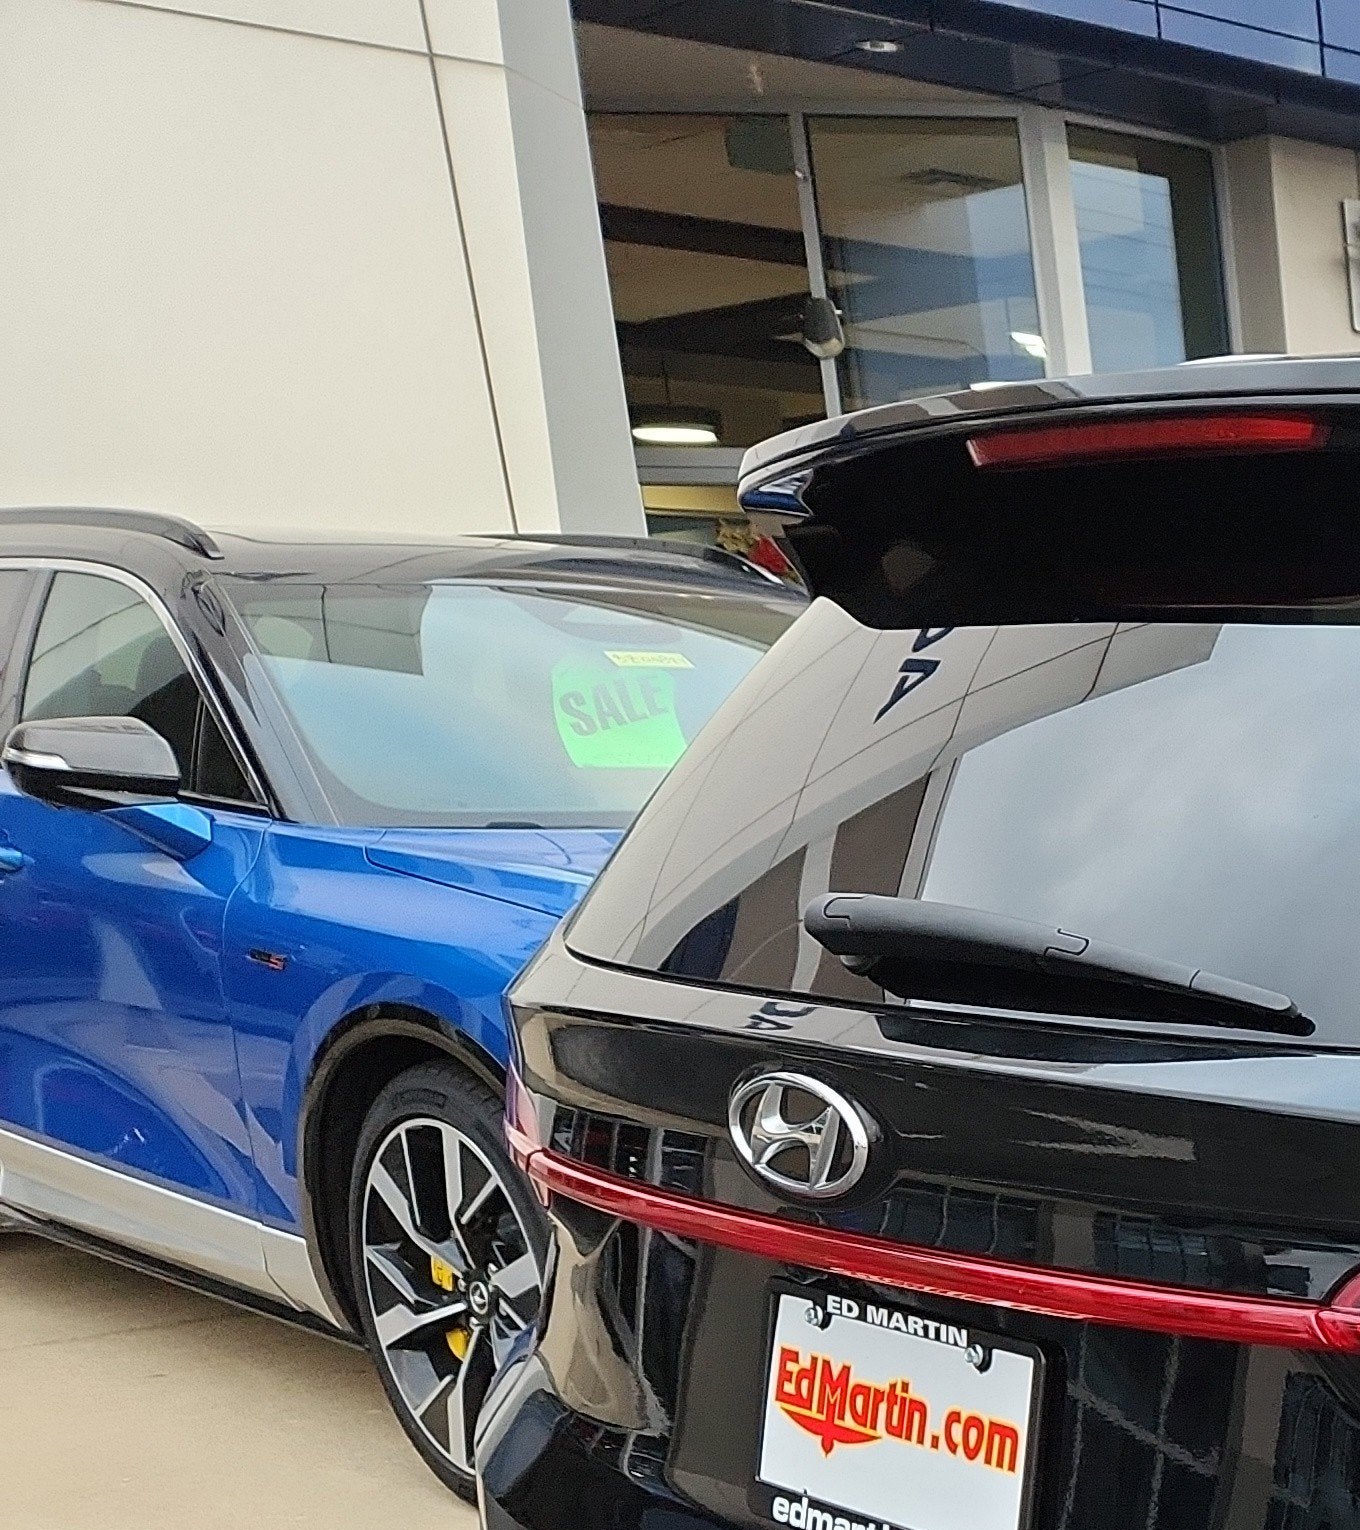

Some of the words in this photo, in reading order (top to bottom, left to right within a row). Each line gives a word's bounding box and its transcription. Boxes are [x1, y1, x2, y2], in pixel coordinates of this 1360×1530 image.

[558, 675, 670, 737] SALE
[826, 1294, 860, 1319] ED
[866, 1304, 969, 1349] MARTIN
[775, 1346, 1020, 1474] EdMartin.com
